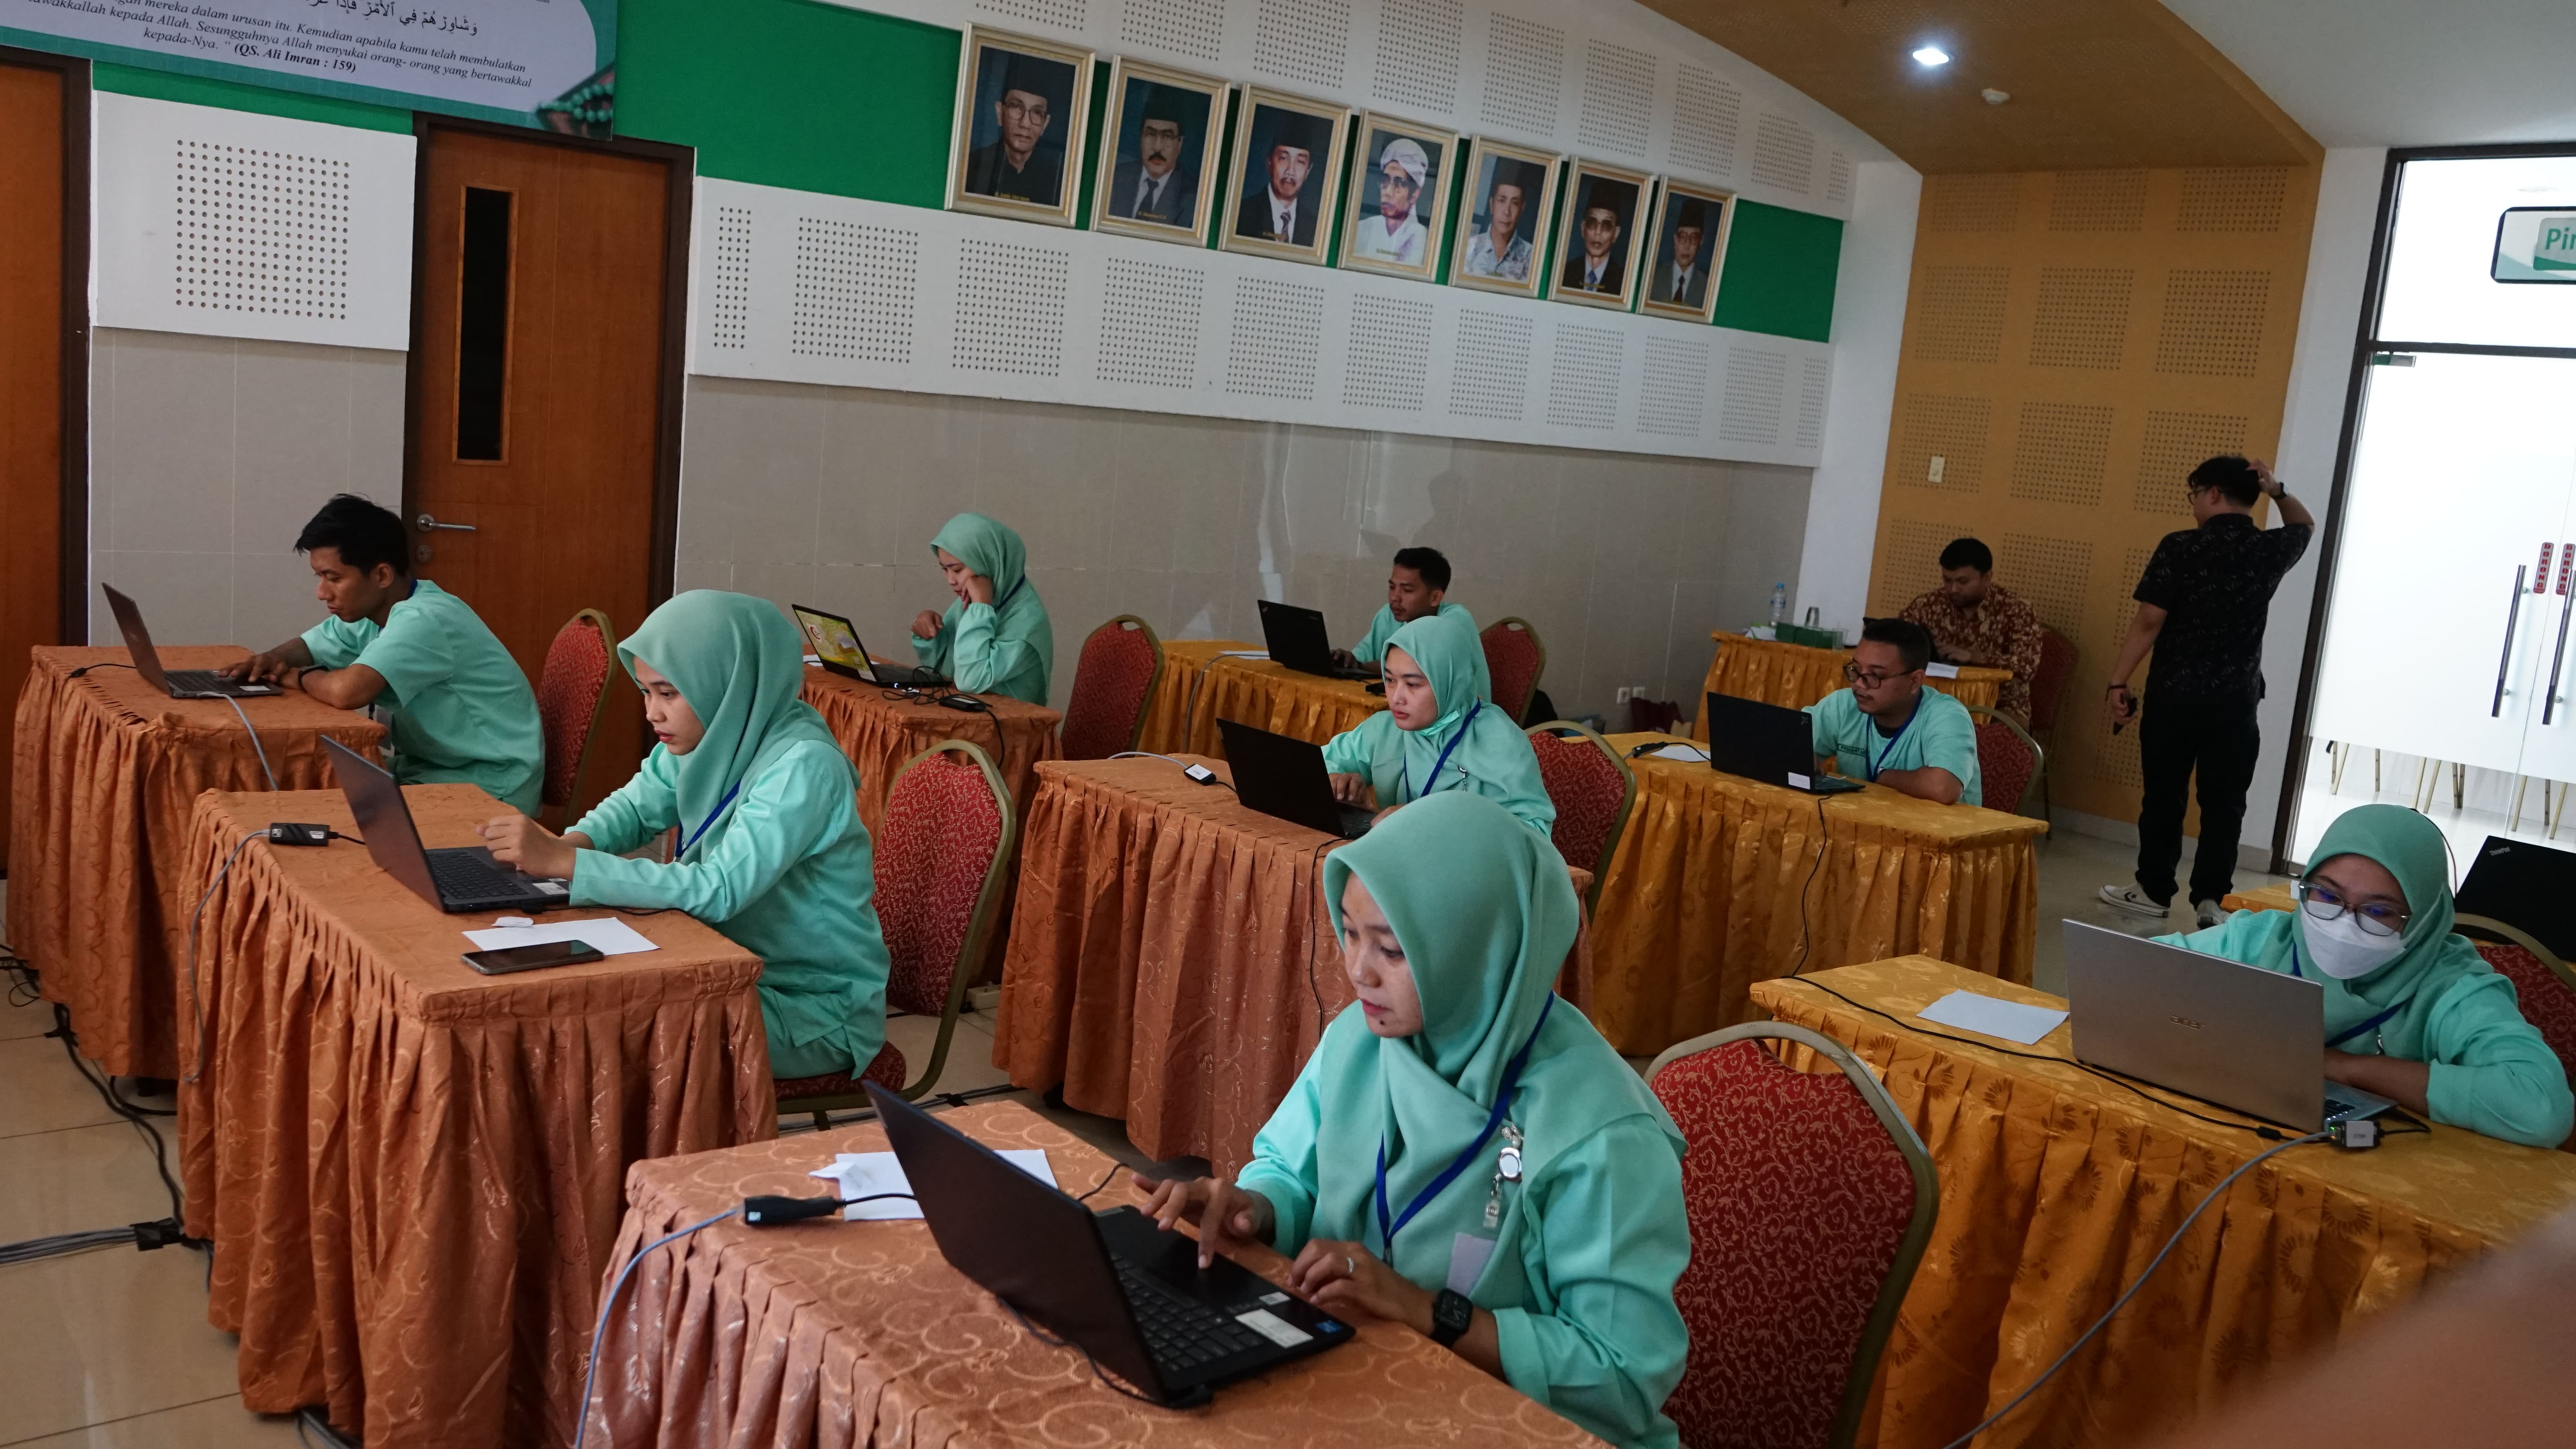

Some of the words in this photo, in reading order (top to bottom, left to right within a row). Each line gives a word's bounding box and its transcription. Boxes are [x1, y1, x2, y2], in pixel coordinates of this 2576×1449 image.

[29, 0, 106, 15] wakkallah
[109, 6, 154, 23] kepada
[156, 15, 192, 30] Allah.
[196, 21, 279, 45] Sesungguhnya
[282, 36, 312, 50] Allah
[316, 44, 368, 60] menyukai
[410, 61, 441, 74] orang
[442, 67, 468, 79] yang
[471, 68, 532, 88] bertawakkal
[144, 27, 218, 49] kepada-Nya.
[234, 43, 260, 57] (QS.
[262, 48, 282, 60] Ali
[284, 51, 320, 66] Imran
[332, 59, 356, 73] 159)
[145, 0, 188, 13] mereka
[191, 5, 228, 20] dalam
[232, 15, 271, 28] urusan
[275, 20, 292, 32] itu.
[296, 23, 352, 42] Kemudian
[355, 36, 397, 50] apabila
[399, 41, 428, 55] kamu
[431, 49, 456, 61] telah
[459, 55, 526, 73] membulatkan
[2537, 543, 2551, 588] DORONG
[2170, 1016, 2206, 1031] acer
